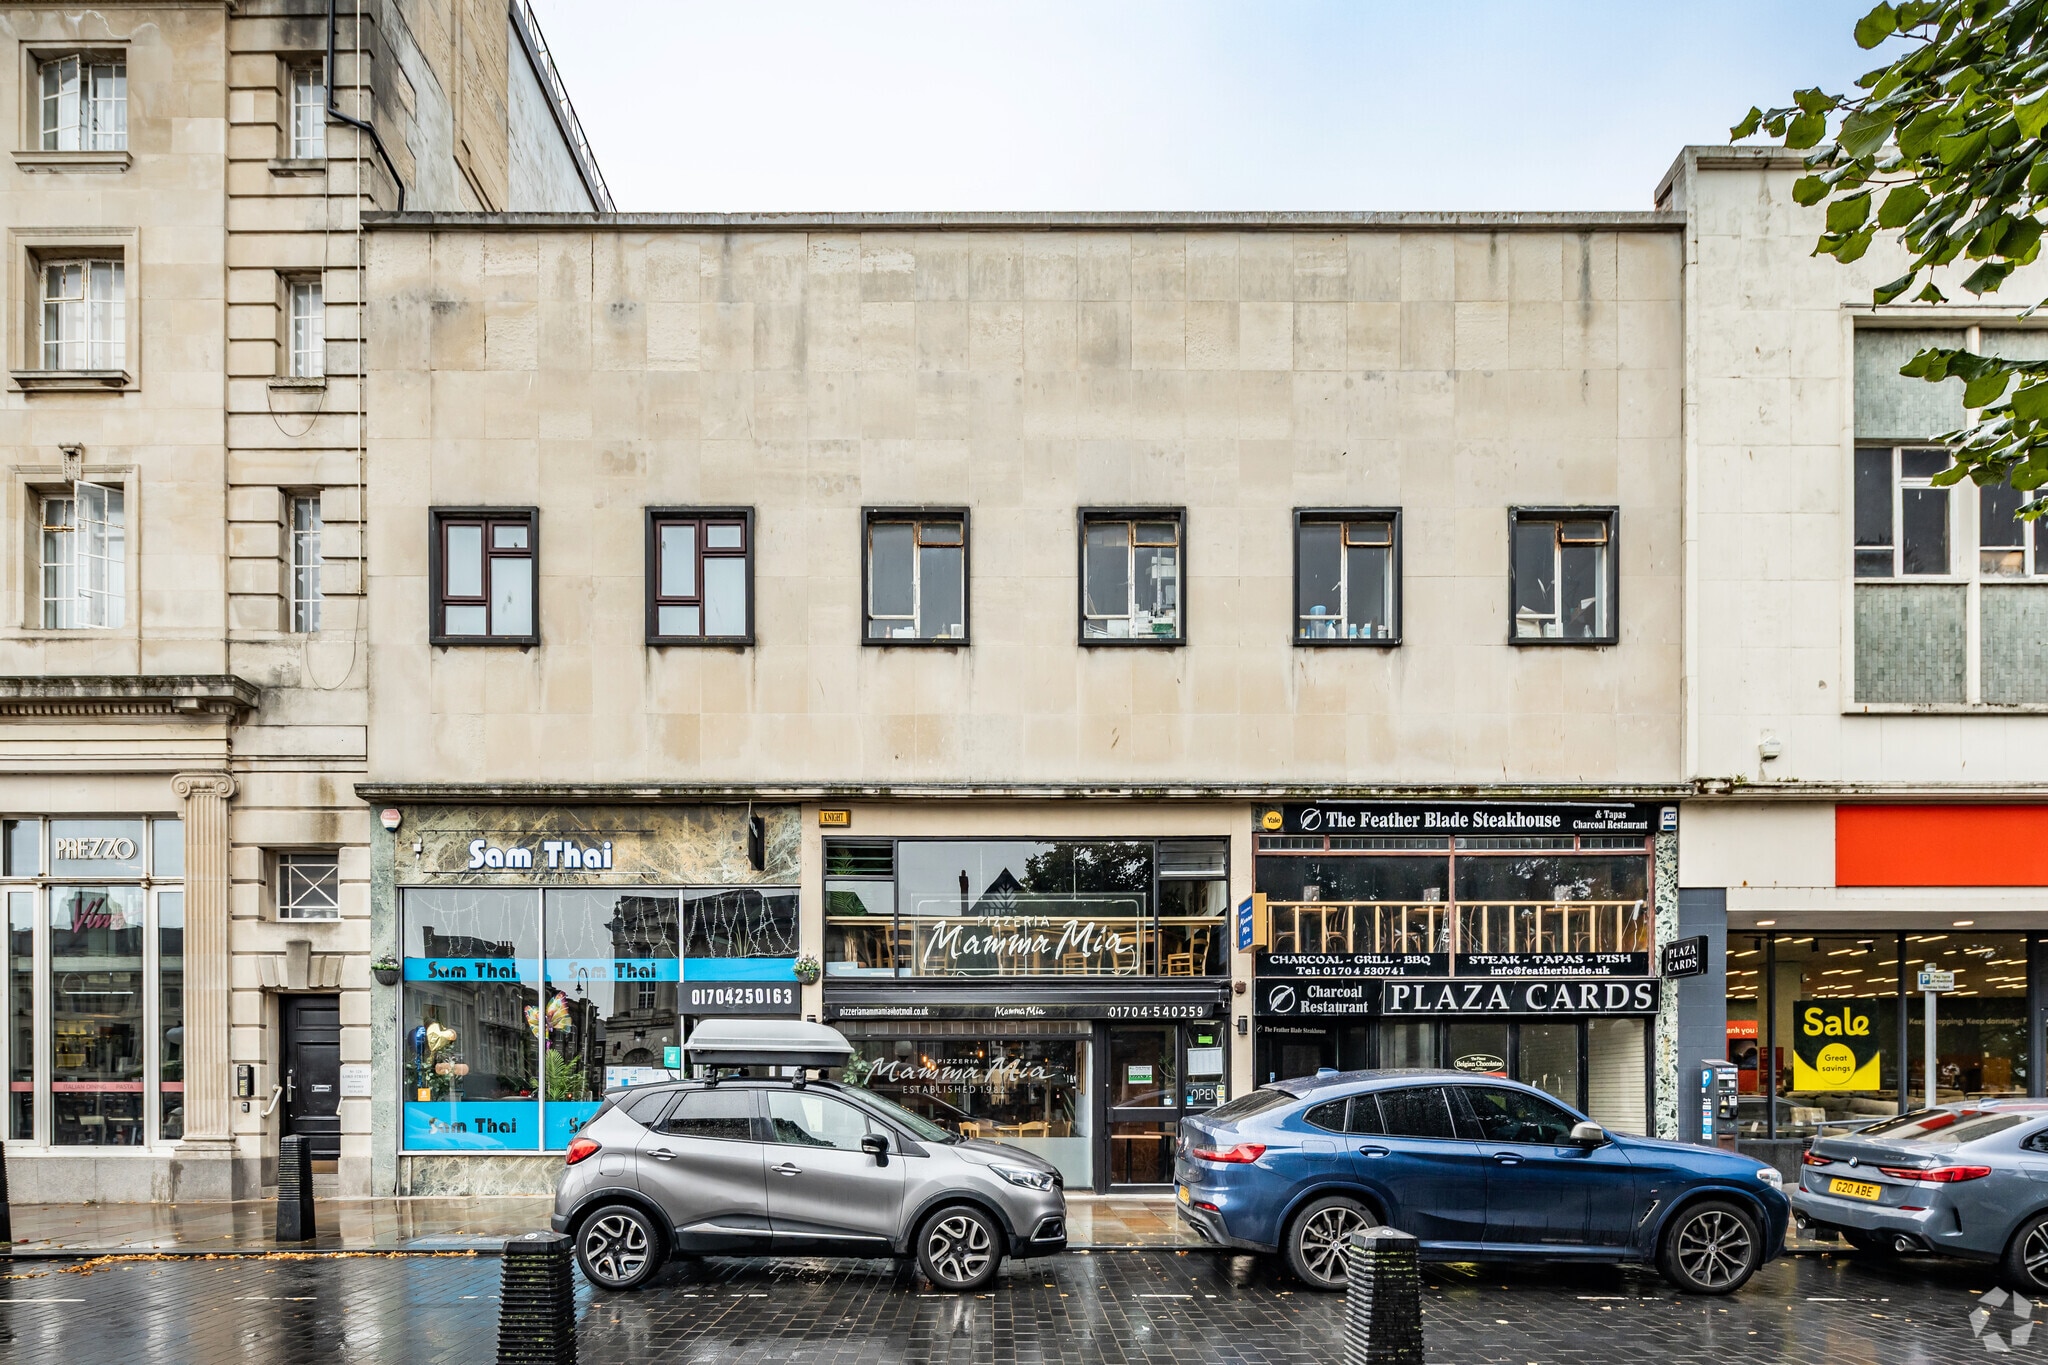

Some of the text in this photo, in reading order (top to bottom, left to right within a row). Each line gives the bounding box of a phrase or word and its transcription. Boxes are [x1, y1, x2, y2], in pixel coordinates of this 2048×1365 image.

[824, 812, 844, 822] KNIGHT
[1326, 811, 1561, 828] The Feather Blade Steakhouse
[1594, 810, 1627, 820] & Tapas
[1664, 813, 1676, 821] ADT
[1572, 820, 1648, 830] Charcoal Restaurant
[56, 837, 138, 860] PREZZO
[468, 838, 614, 870] Sam Thai
[978, 916, 1050, 928] PIZZERIA
[922, 920, 1134, 964] Mamma Mia
[1668, 944, 1696, 959] PLAZA
[1270, 955, 1344, 964] CHARCOAL
[1354, 955, 1394, 964] GRILL
[1404, 955, 1432, 966] BBQ
[1469, 954, 1520, 964] STEAK
[1532, 954, 1584, 964] TAPAS
[1596, 954, 1632, 964] FISH
[1667, 957, 1698, 972] CARDS
[428, 961, 517, 978] Sam Thai
[568, 962, 656, 978] Sam Thai
[1296, 966, 1406, 976] Tel: 01704 530741
[1490, 966, 1610, 976] info@featherblade.uk
[691, 988, 792, 1006] 01704250163
[1307, 986, 1362, 998] Charcoal
[1390, 983, 1652, 1010] PLAZA CARDS
[994, 1006, 1026, 1018] Mamma
[1026, 1006, 1046, 1018] Mia
[1300, 1000, 1368, 1013] Restaurant
[1803, 1006, 1870, 1036] Sale
[864, 1056, 1056, 1084] Mamma Mia
[1822, 1064, 1850, 1072] savings
[902, 1085, 976, 1094] ESTABLISHED
[1191, 1088, 1217, 1101] OPEN
[428, 1117, 517, 1134] Sam Thai
[1836, 1182, 1874, 1198] G20 ABE
